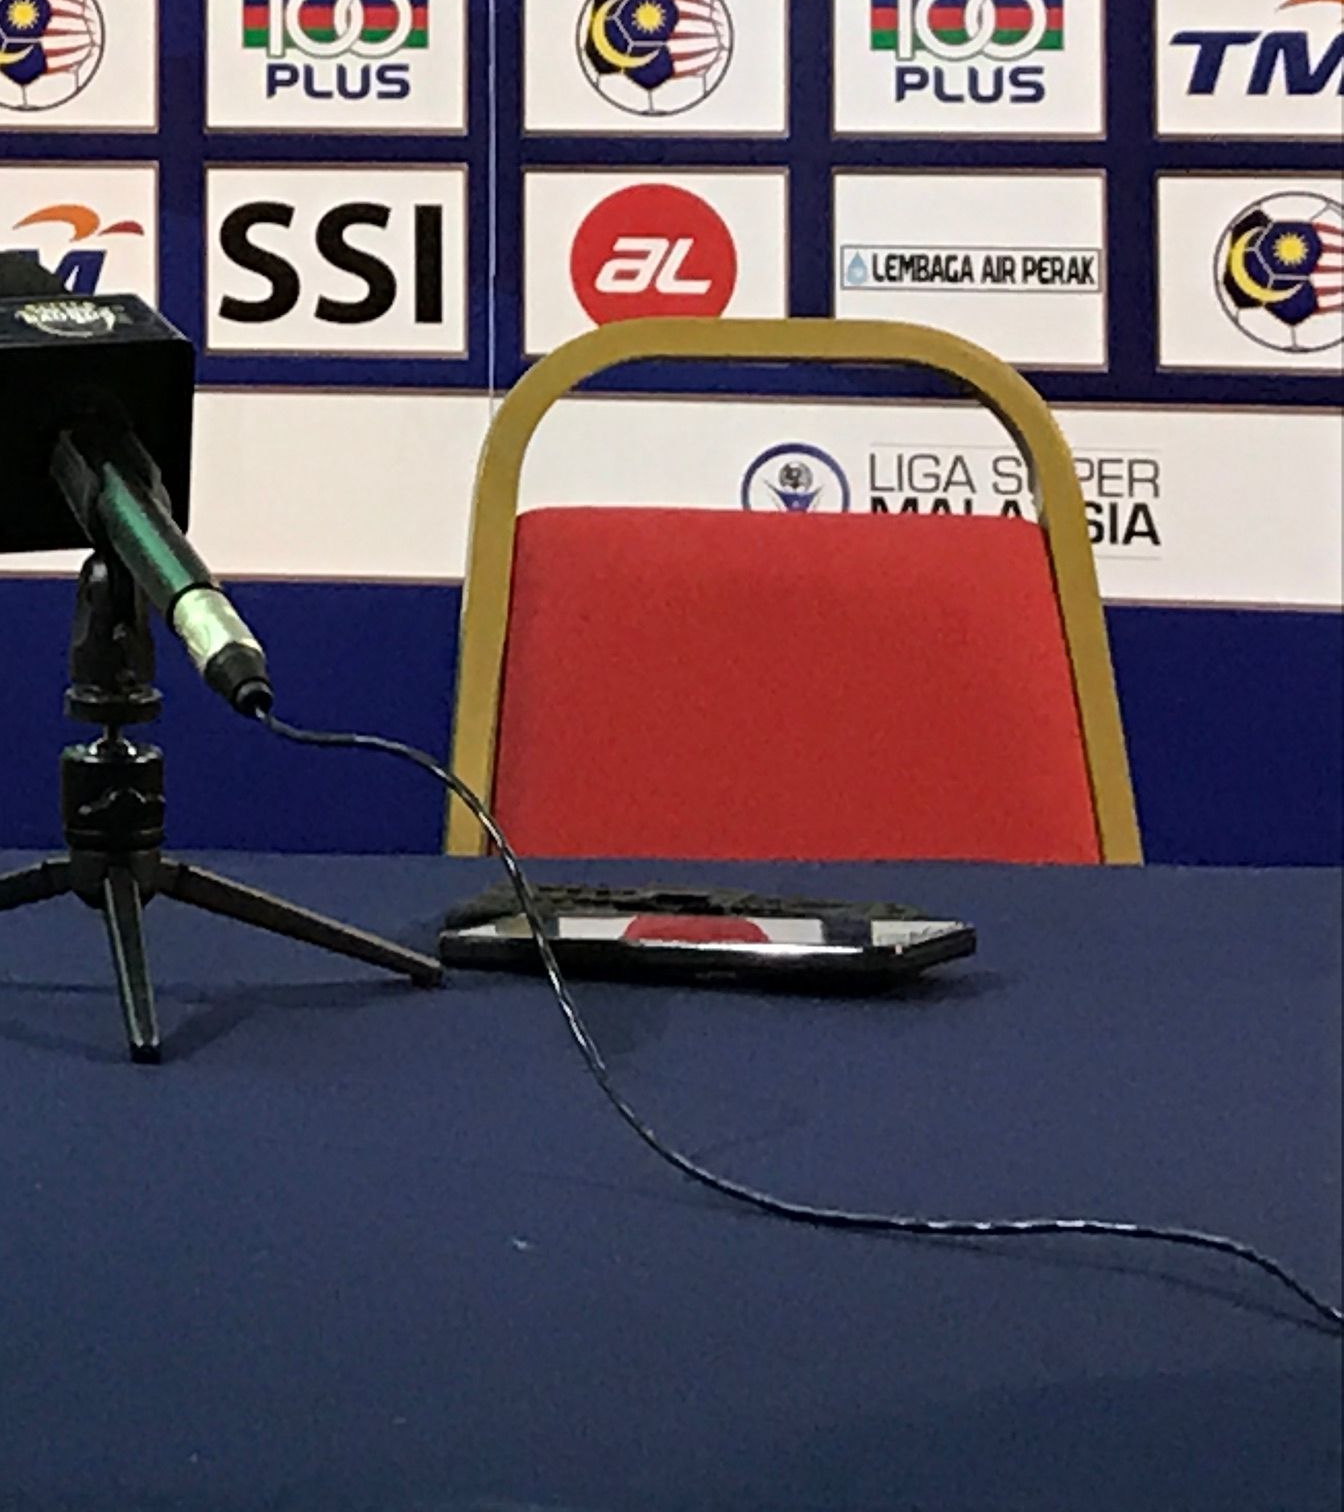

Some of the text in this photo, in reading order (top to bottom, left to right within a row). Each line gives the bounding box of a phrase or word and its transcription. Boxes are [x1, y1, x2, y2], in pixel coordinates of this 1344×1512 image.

[266, 63, 411, 100] PLUS
[1170, 31, 1344, 97] TM
[895, 65, 1046, 104] PLUS
[218, 201, 443, 325] SSI
[872, 253, 1095, 285] LEMBAGA AIR PERAK
[869, 453, 977, 495] LIGA
